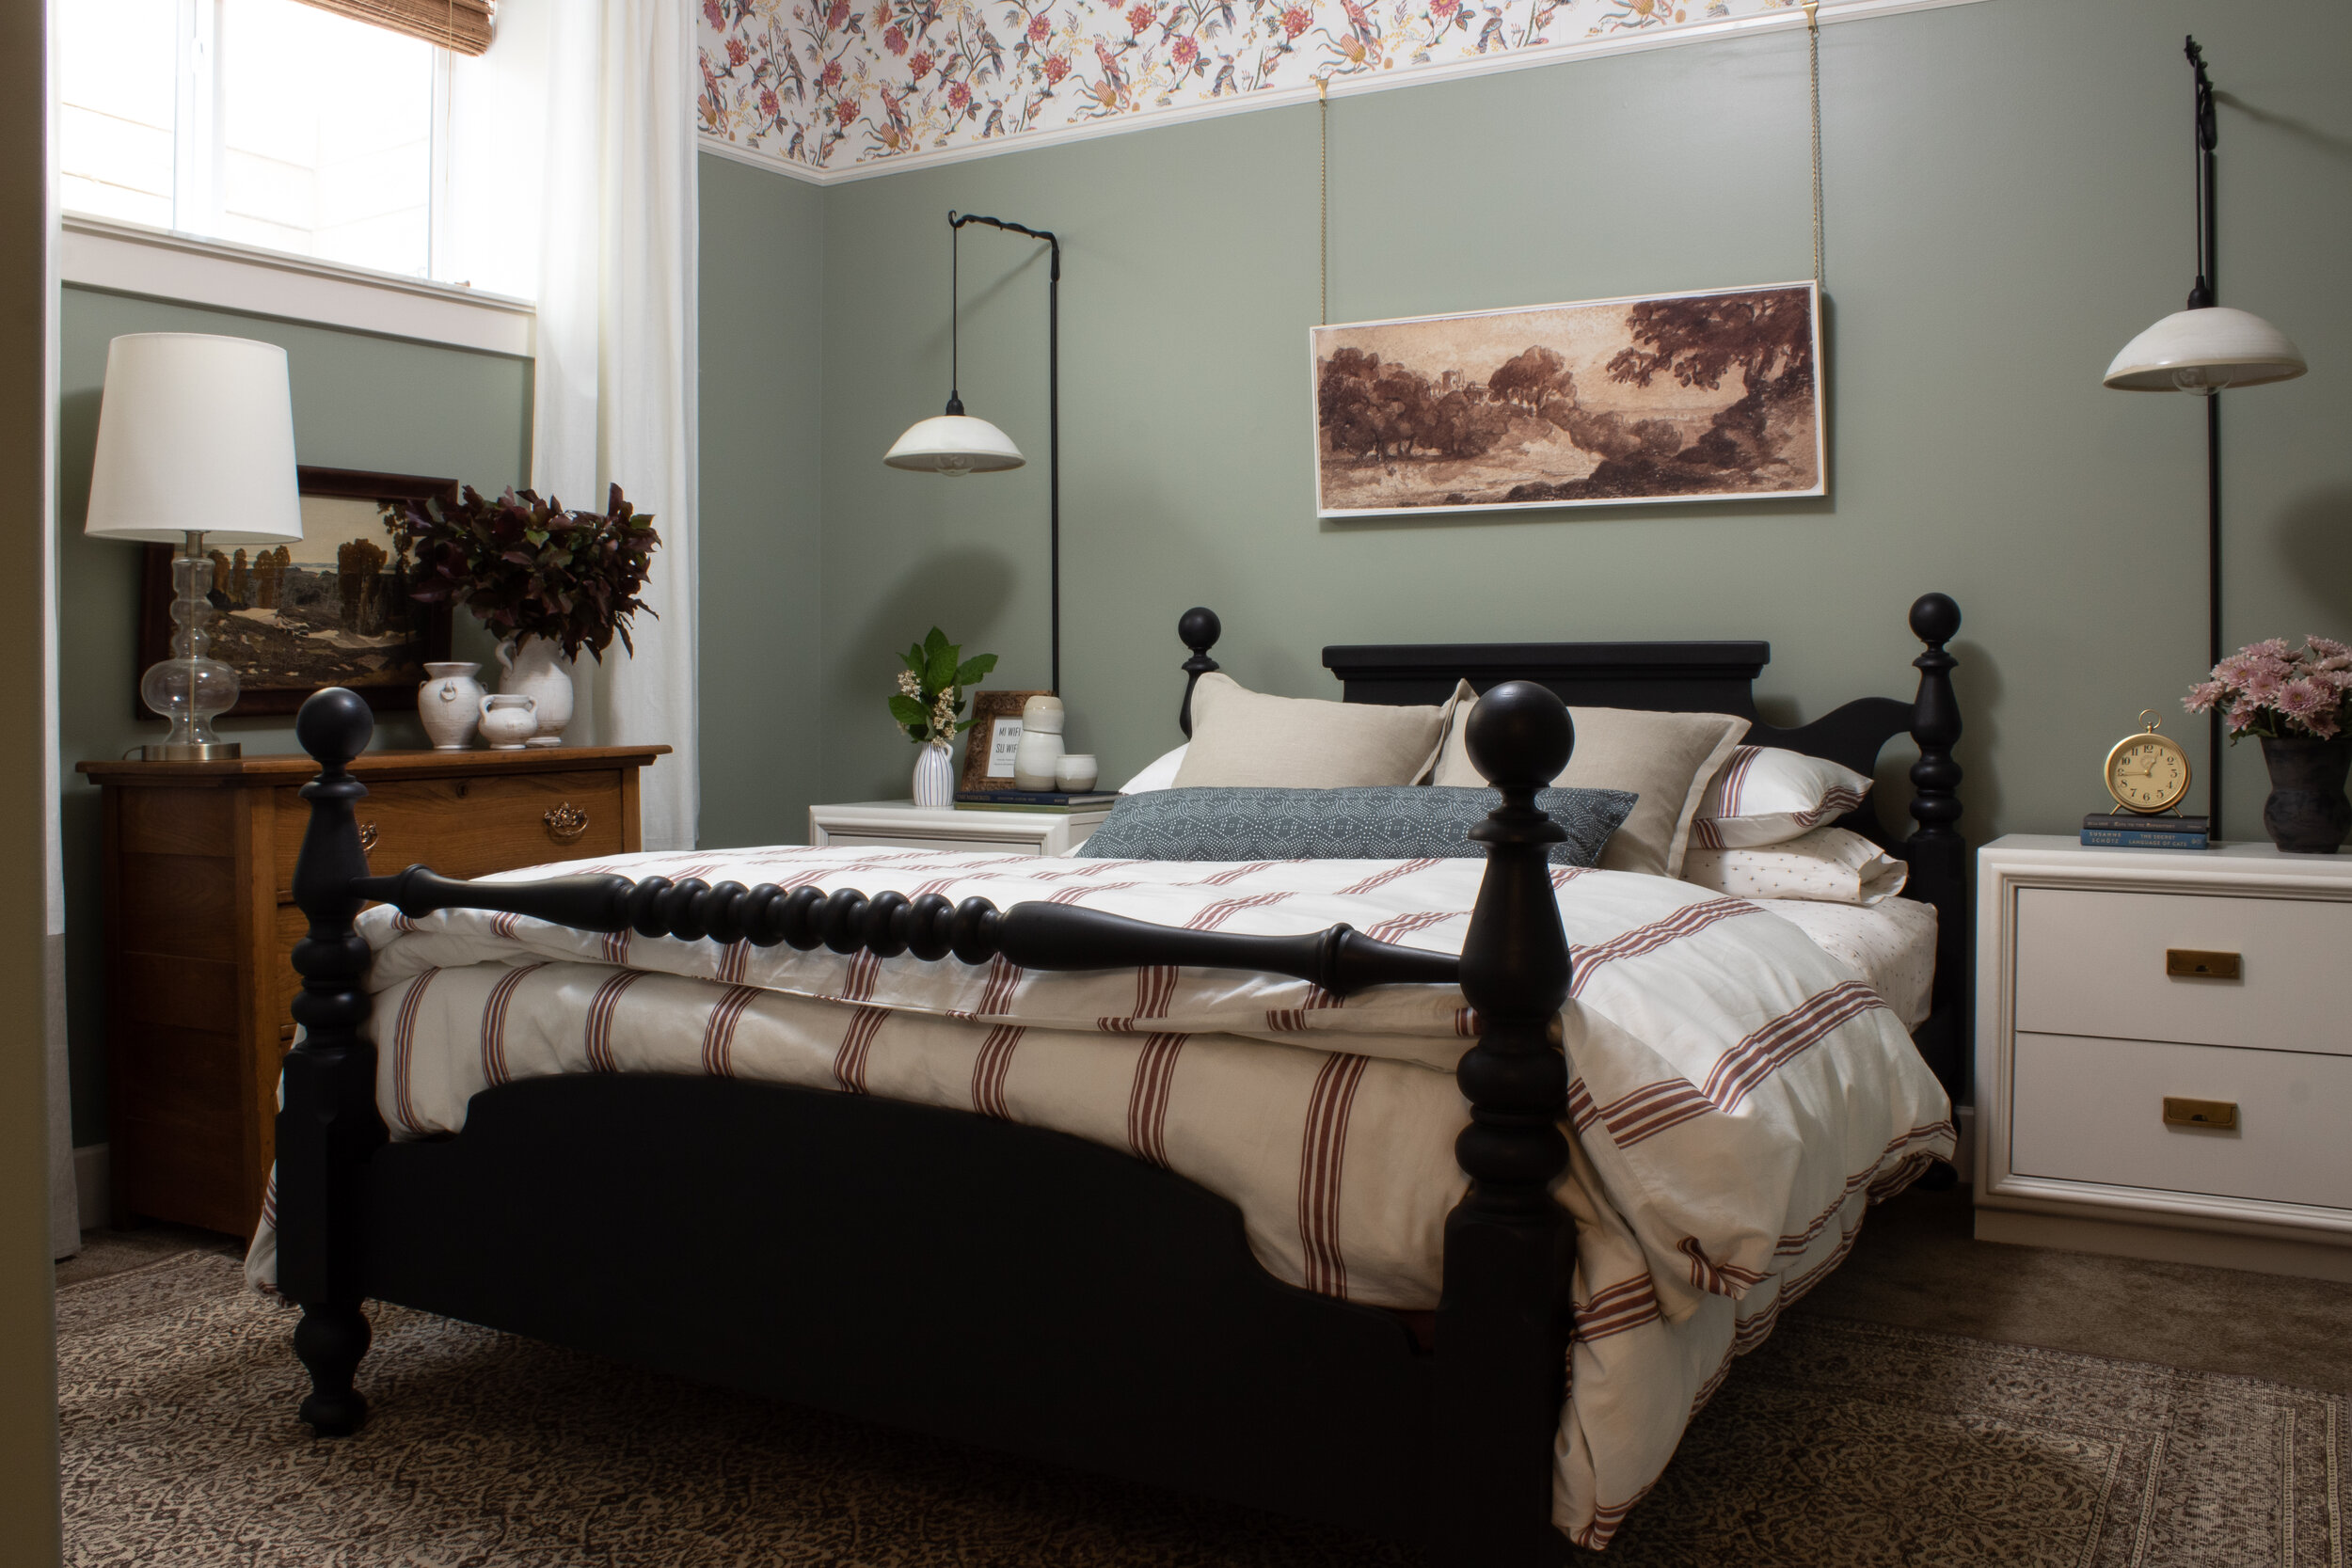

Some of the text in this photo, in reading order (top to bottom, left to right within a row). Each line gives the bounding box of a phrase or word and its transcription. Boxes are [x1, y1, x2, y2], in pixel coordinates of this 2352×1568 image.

[998, 726, 1021, 736] MI WIFI
[995, 743, 1017, 753] SU WIF
[2131, 748, 2137, 756] 11
[2159, 748, 2163, 756] 1
[2167, 756, 2174, 766] 2
[2117, 768, 2124, 776] 9
[2169, 768, 2177, 778] 3
[2121, 779, 2128, 787] 8
[2166, 781, 2172, 789] 4
[2130, 788, 2137, 797] 7
[2156, 789, 2164, 799] 5
